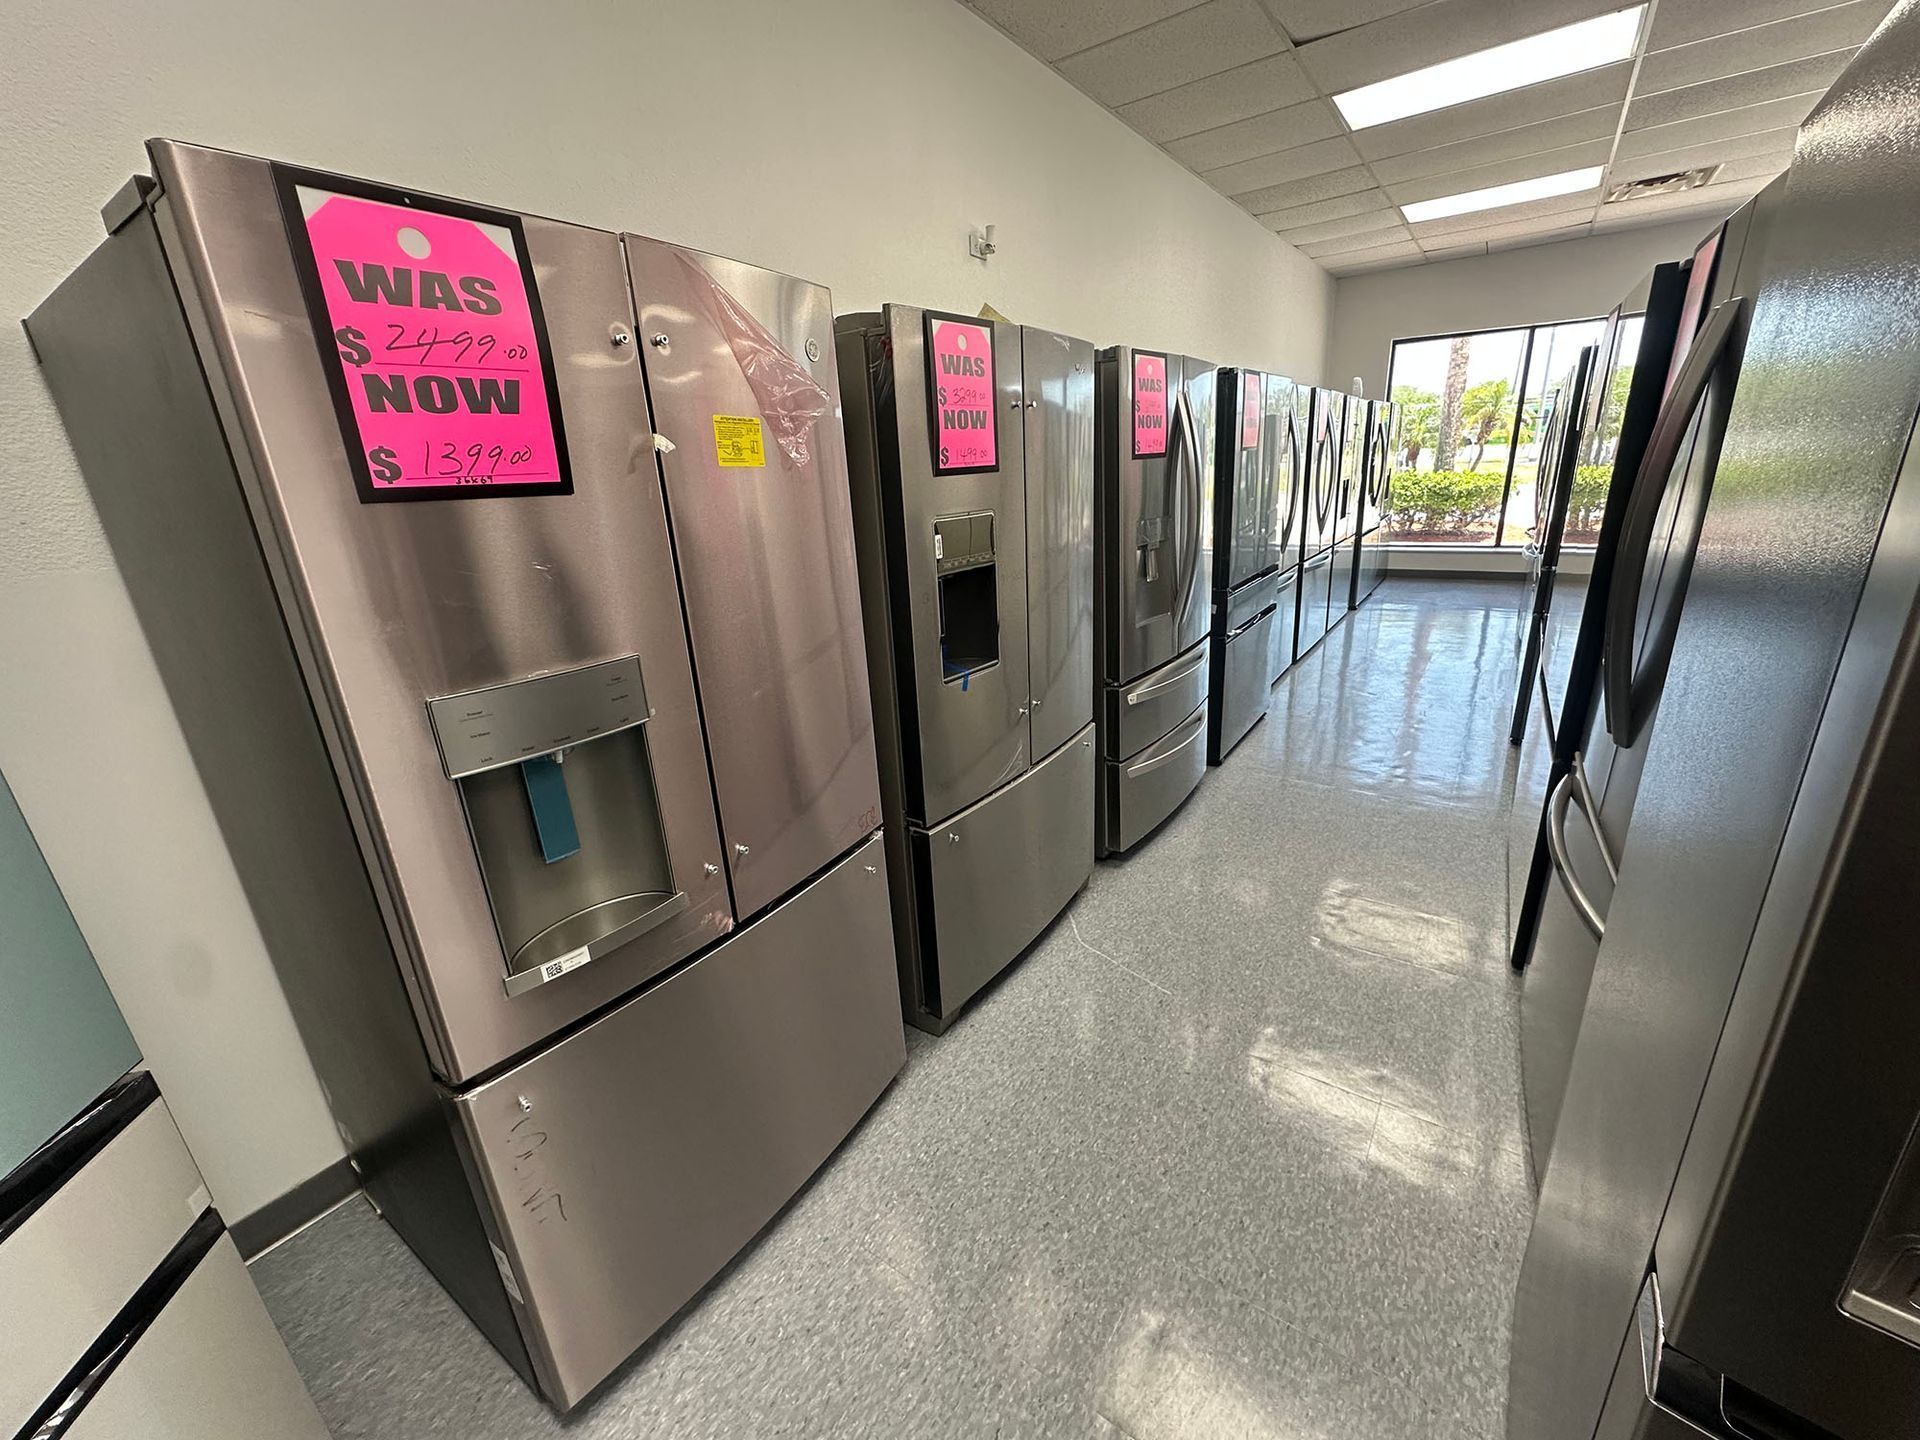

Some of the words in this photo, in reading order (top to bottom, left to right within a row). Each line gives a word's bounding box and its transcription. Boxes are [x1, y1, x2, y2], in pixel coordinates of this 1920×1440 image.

[333, 259, 502, 316] WAS
[335, 325, 372, 367] $
[941, 353, 985, 377] WAS
[361, 374, 520, 415] NOW
[1138, 377, 1162, 392] WAS
[939, 386, 947, 407] $
[943, 409, 987, 429] NOW
[1137, 415, 1162, 428] NOW
[369, 445, 402, 484] $
[941, 446, 949, 466] $
